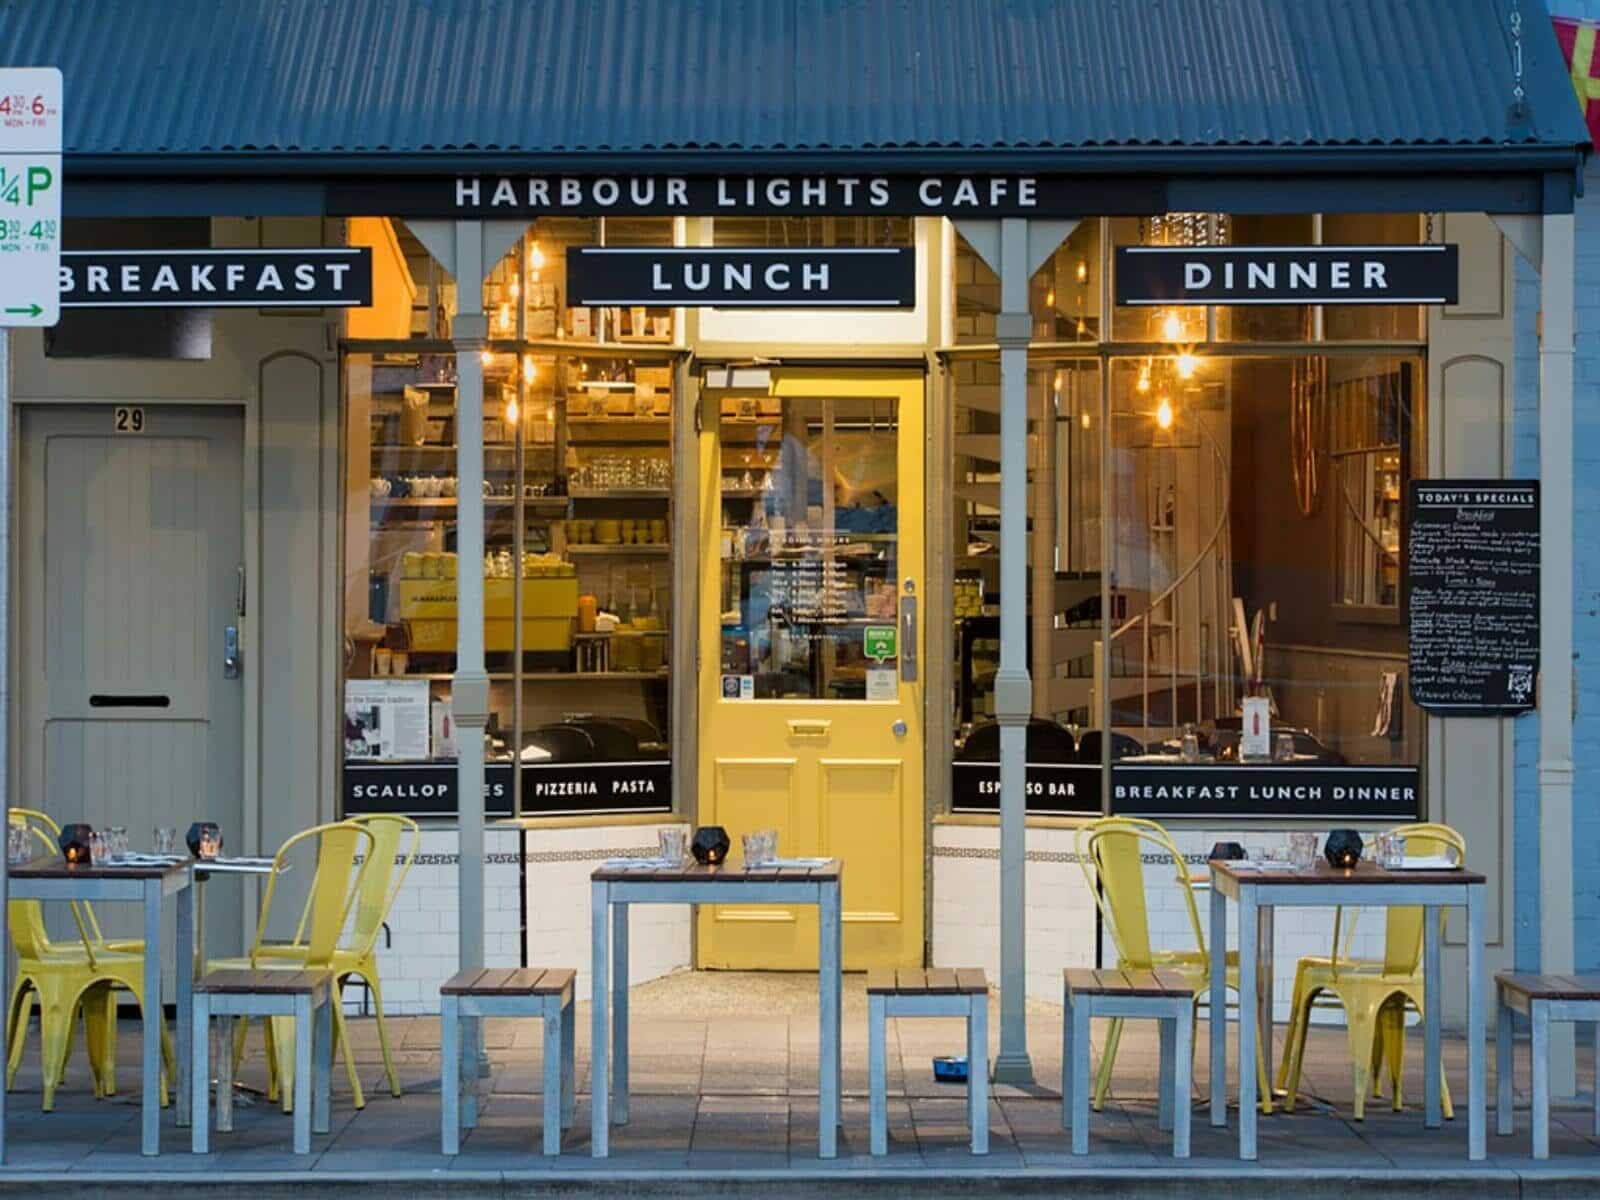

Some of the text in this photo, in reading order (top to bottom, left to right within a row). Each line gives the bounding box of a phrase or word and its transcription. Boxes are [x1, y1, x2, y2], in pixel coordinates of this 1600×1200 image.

[455, 178, 1038, 207] HARBOUR LIGHTS CAFE
[58, 264, 350, 292] BREAKFAST
[652, 263, 830, 291] LUNCH
[1184, 262, 1388, 290] DINNER
[117, 409, 142, 431] 29
[1418, 493, 1534, 503] TODAY'S SPECIALS
[353, 784, 448, 797] SCALLOP
[536, 780, 655, 796] PIZZERIA PASTA
[979, 781, 1075, 796] ESPSO BAR
[1115, 786, 1415, 801] BREAKFAST LUNCH DINNER
